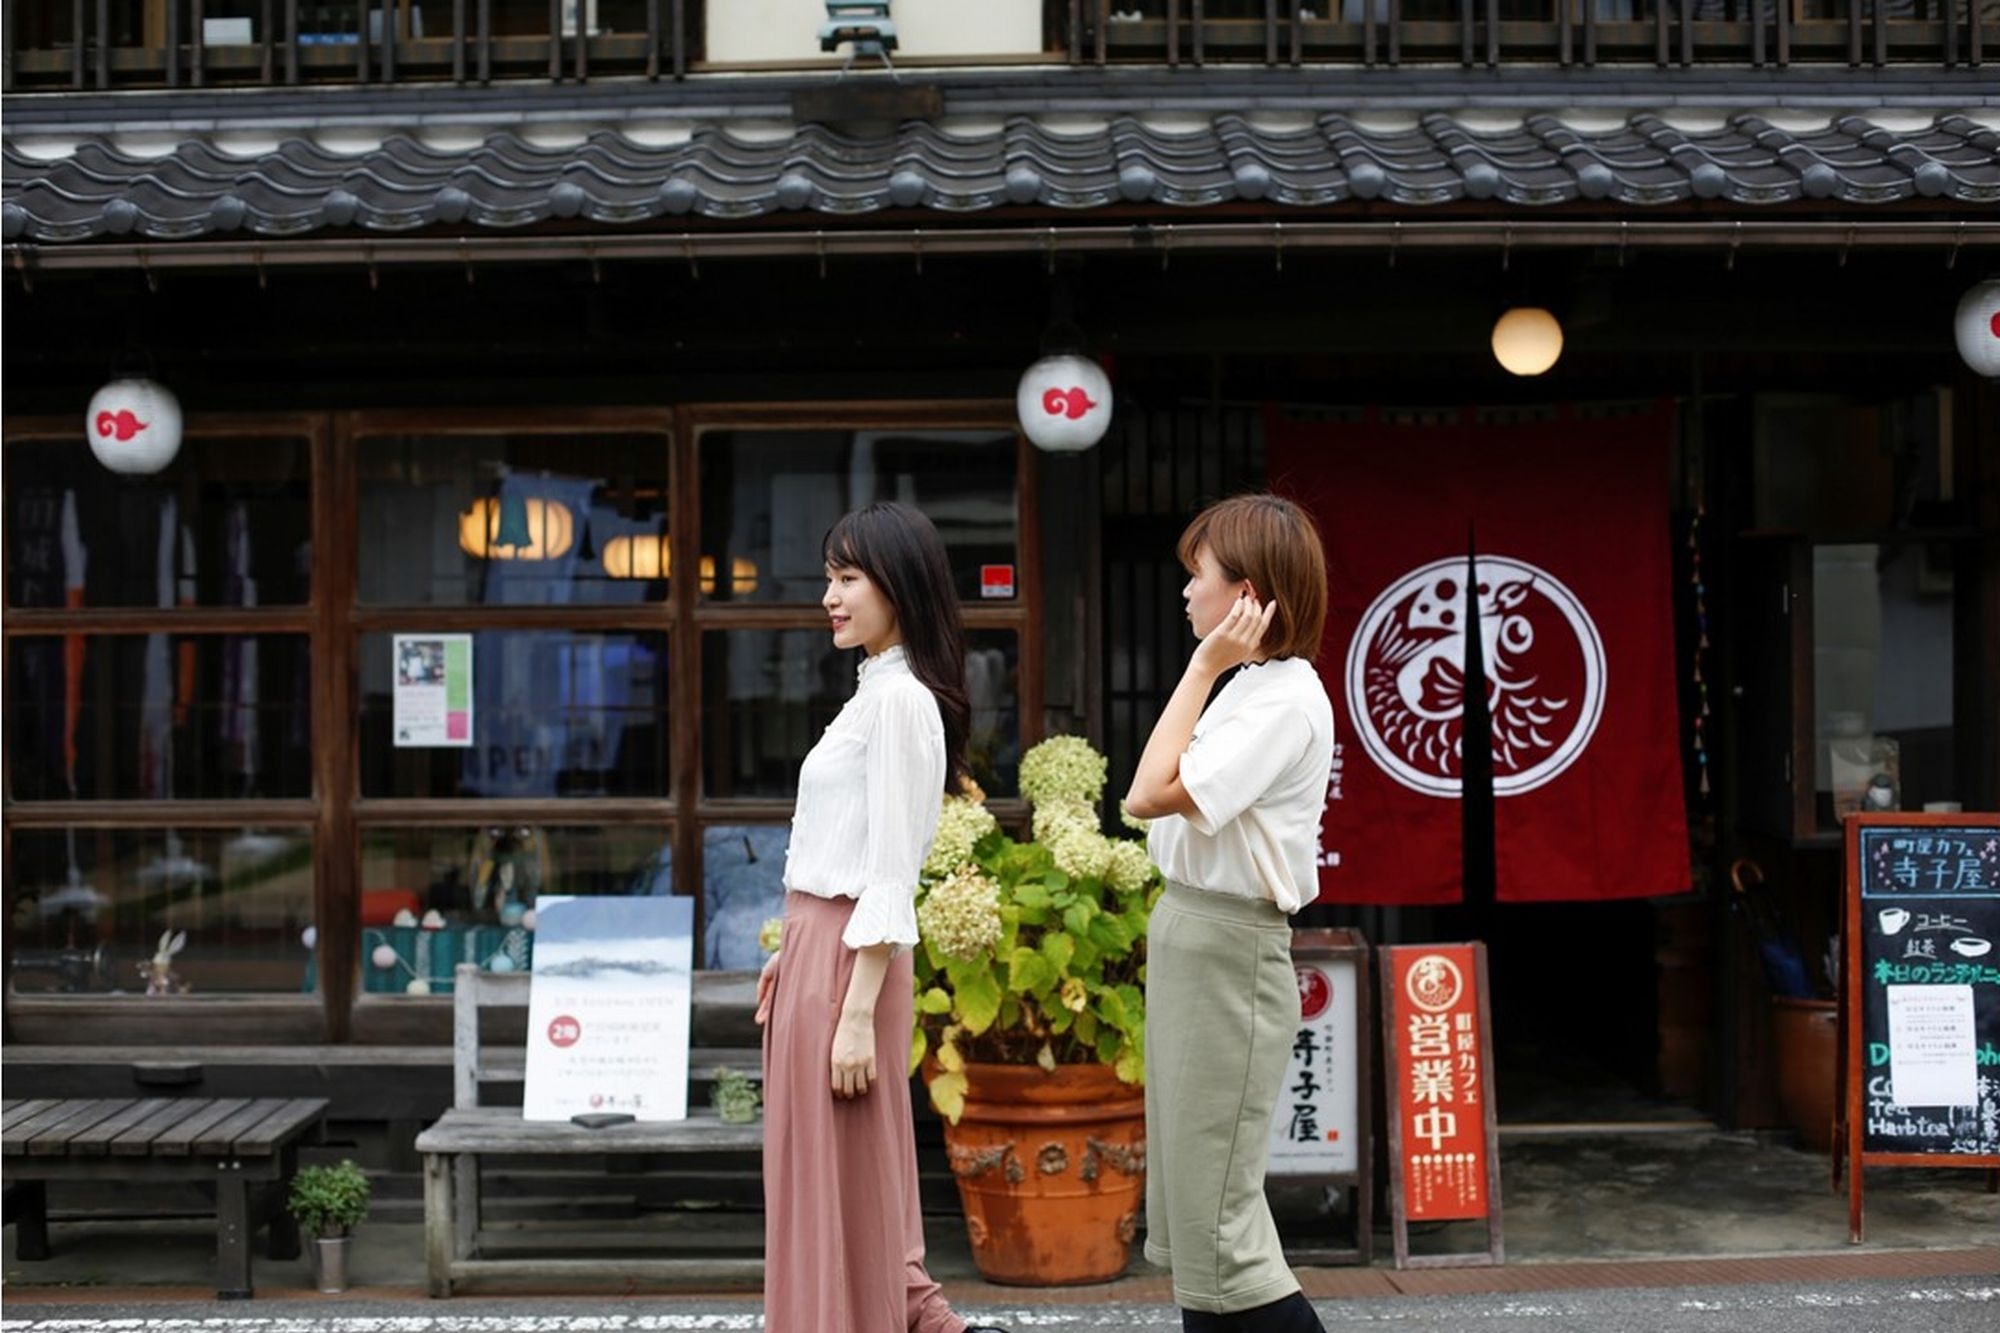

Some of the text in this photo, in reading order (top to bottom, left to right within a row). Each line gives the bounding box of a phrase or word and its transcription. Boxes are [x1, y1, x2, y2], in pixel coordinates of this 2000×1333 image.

[1893, 837, 1974, 857] 町屋カフェ
[1892, 855, 1989, 890] 寺子屋
[1917, 914, 1967, 927] コーヒー
[1906, 938, 1936, 954] 紅茶
[1289, 1027, 1321, 1143] 寺子屋
[1408, 1012, 1457, 1151] 営業中
